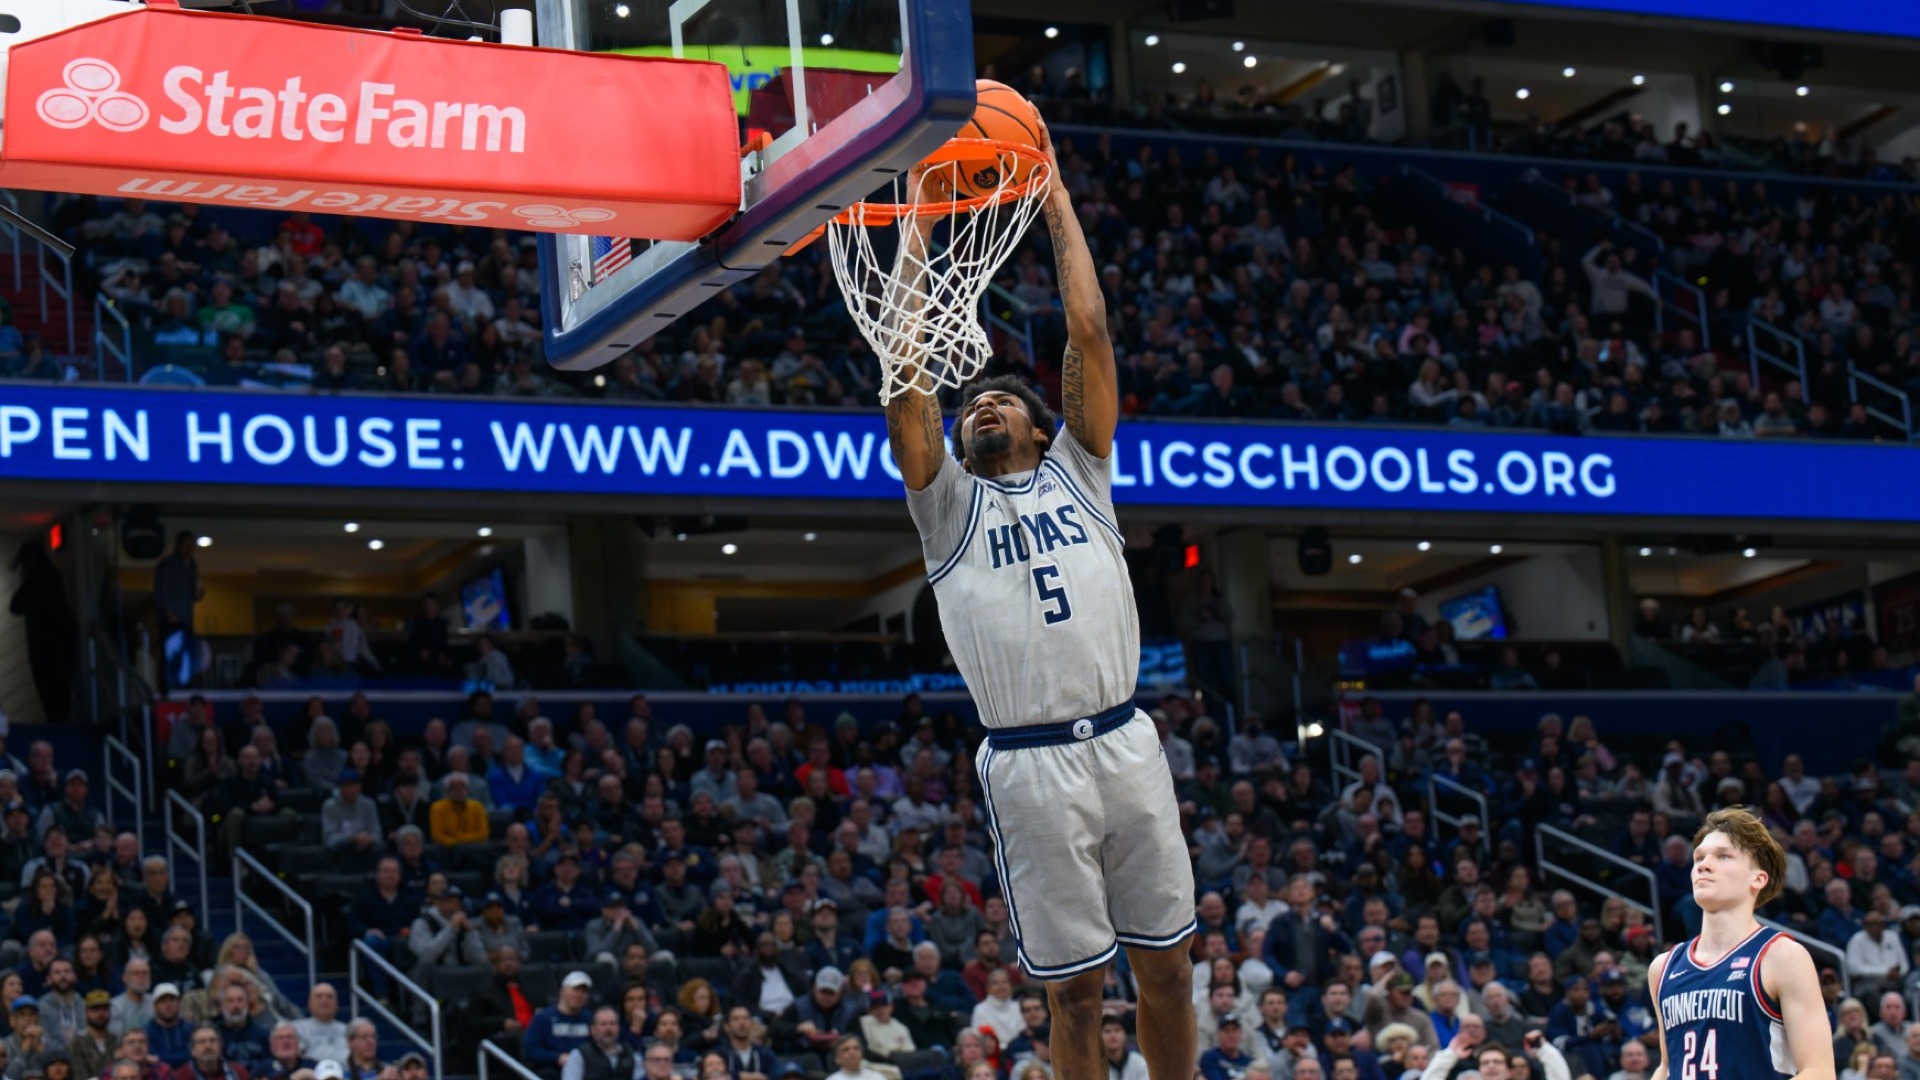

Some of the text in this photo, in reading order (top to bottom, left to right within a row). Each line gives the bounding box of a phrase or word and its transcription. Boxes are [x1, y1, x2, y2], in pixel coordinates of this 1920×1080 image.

[186, 411, 465, 470] HOUSE:
[987, 504, 1089, 570] HOYAS
[1032, 564, 1072, 627] 5
[1661, 988, 1745, 1031] CONNECTICUT
[1681, 1028, 1719, 1080] 24
